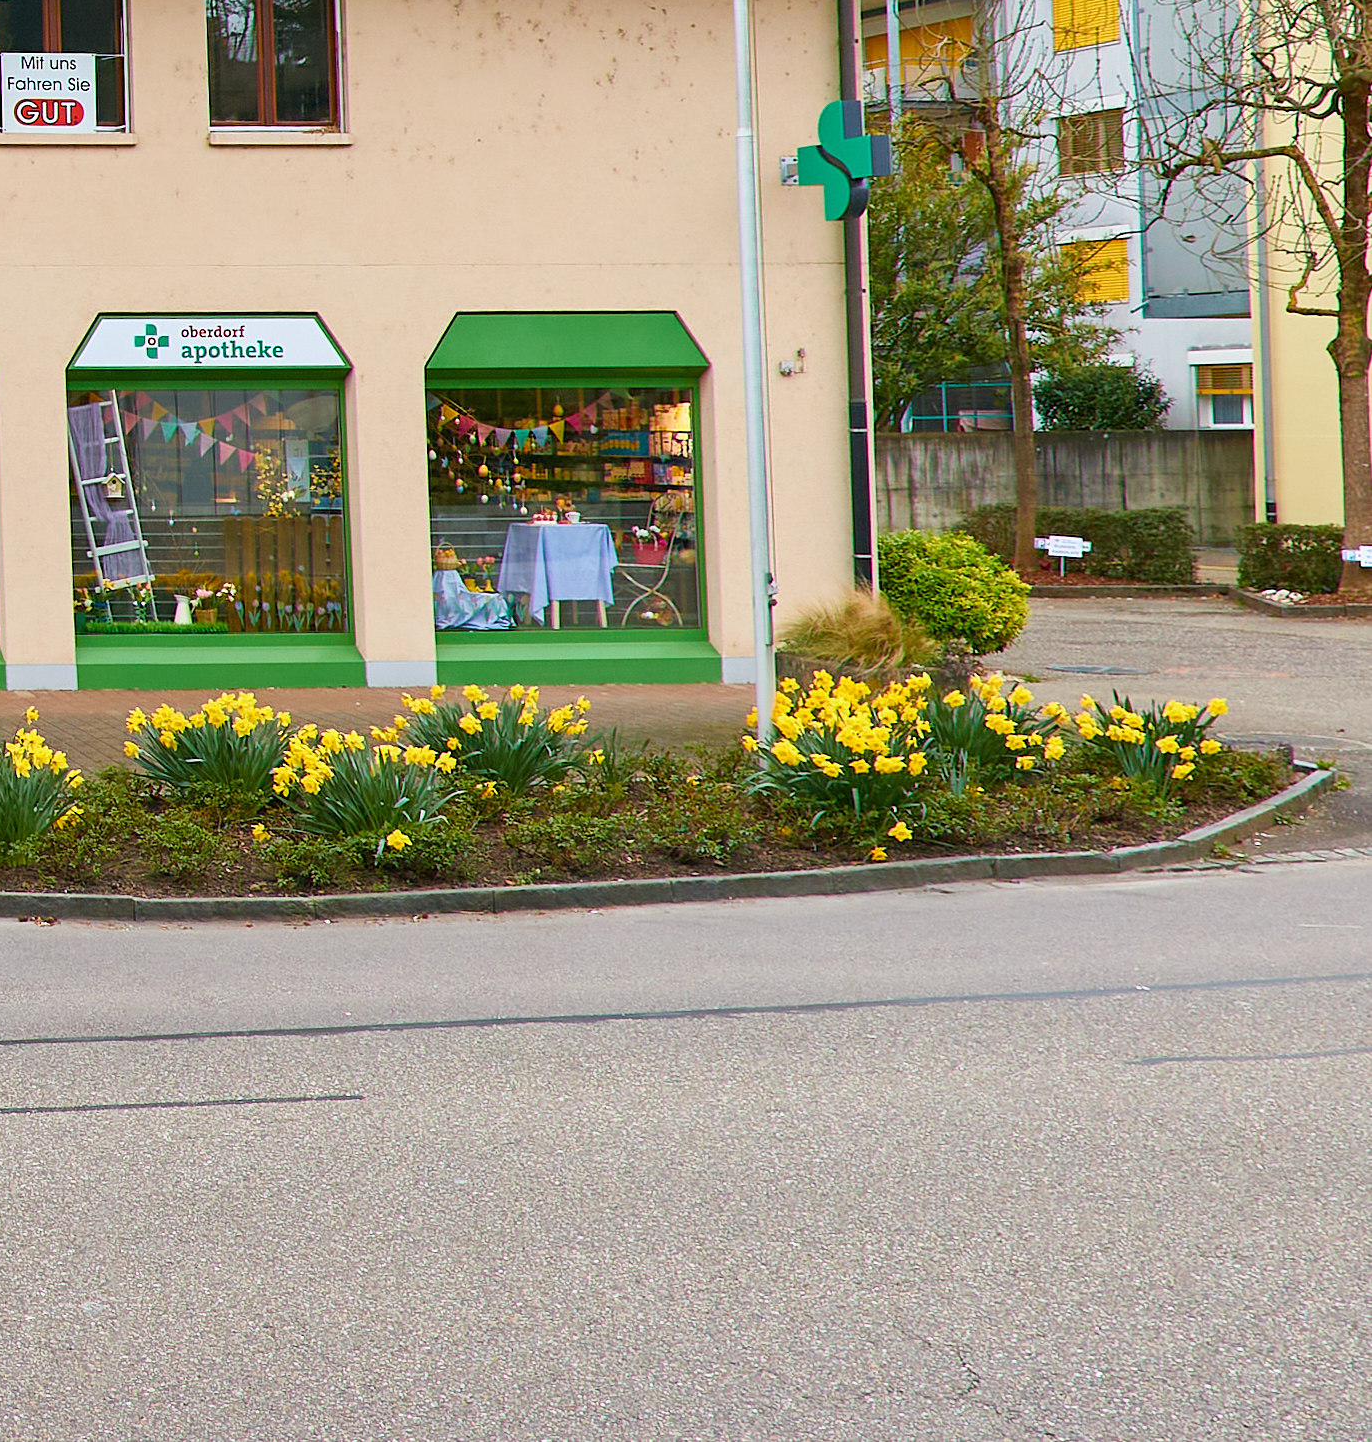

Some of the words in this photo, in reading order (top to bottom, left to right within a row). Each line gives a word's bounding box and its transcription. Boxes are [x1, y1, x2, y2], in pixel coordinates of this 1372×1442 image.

[21, 56, 45, 70] Mit
[50, 59, 77, 70] uns
[7, 76, 62, 91] Fahren
[67, 77, 91, 92] Sie
[16, 101, 76, 125] GUT
[181, 325, 246, 338] oberdorf
[181, 340, 284, 364] apotheke
